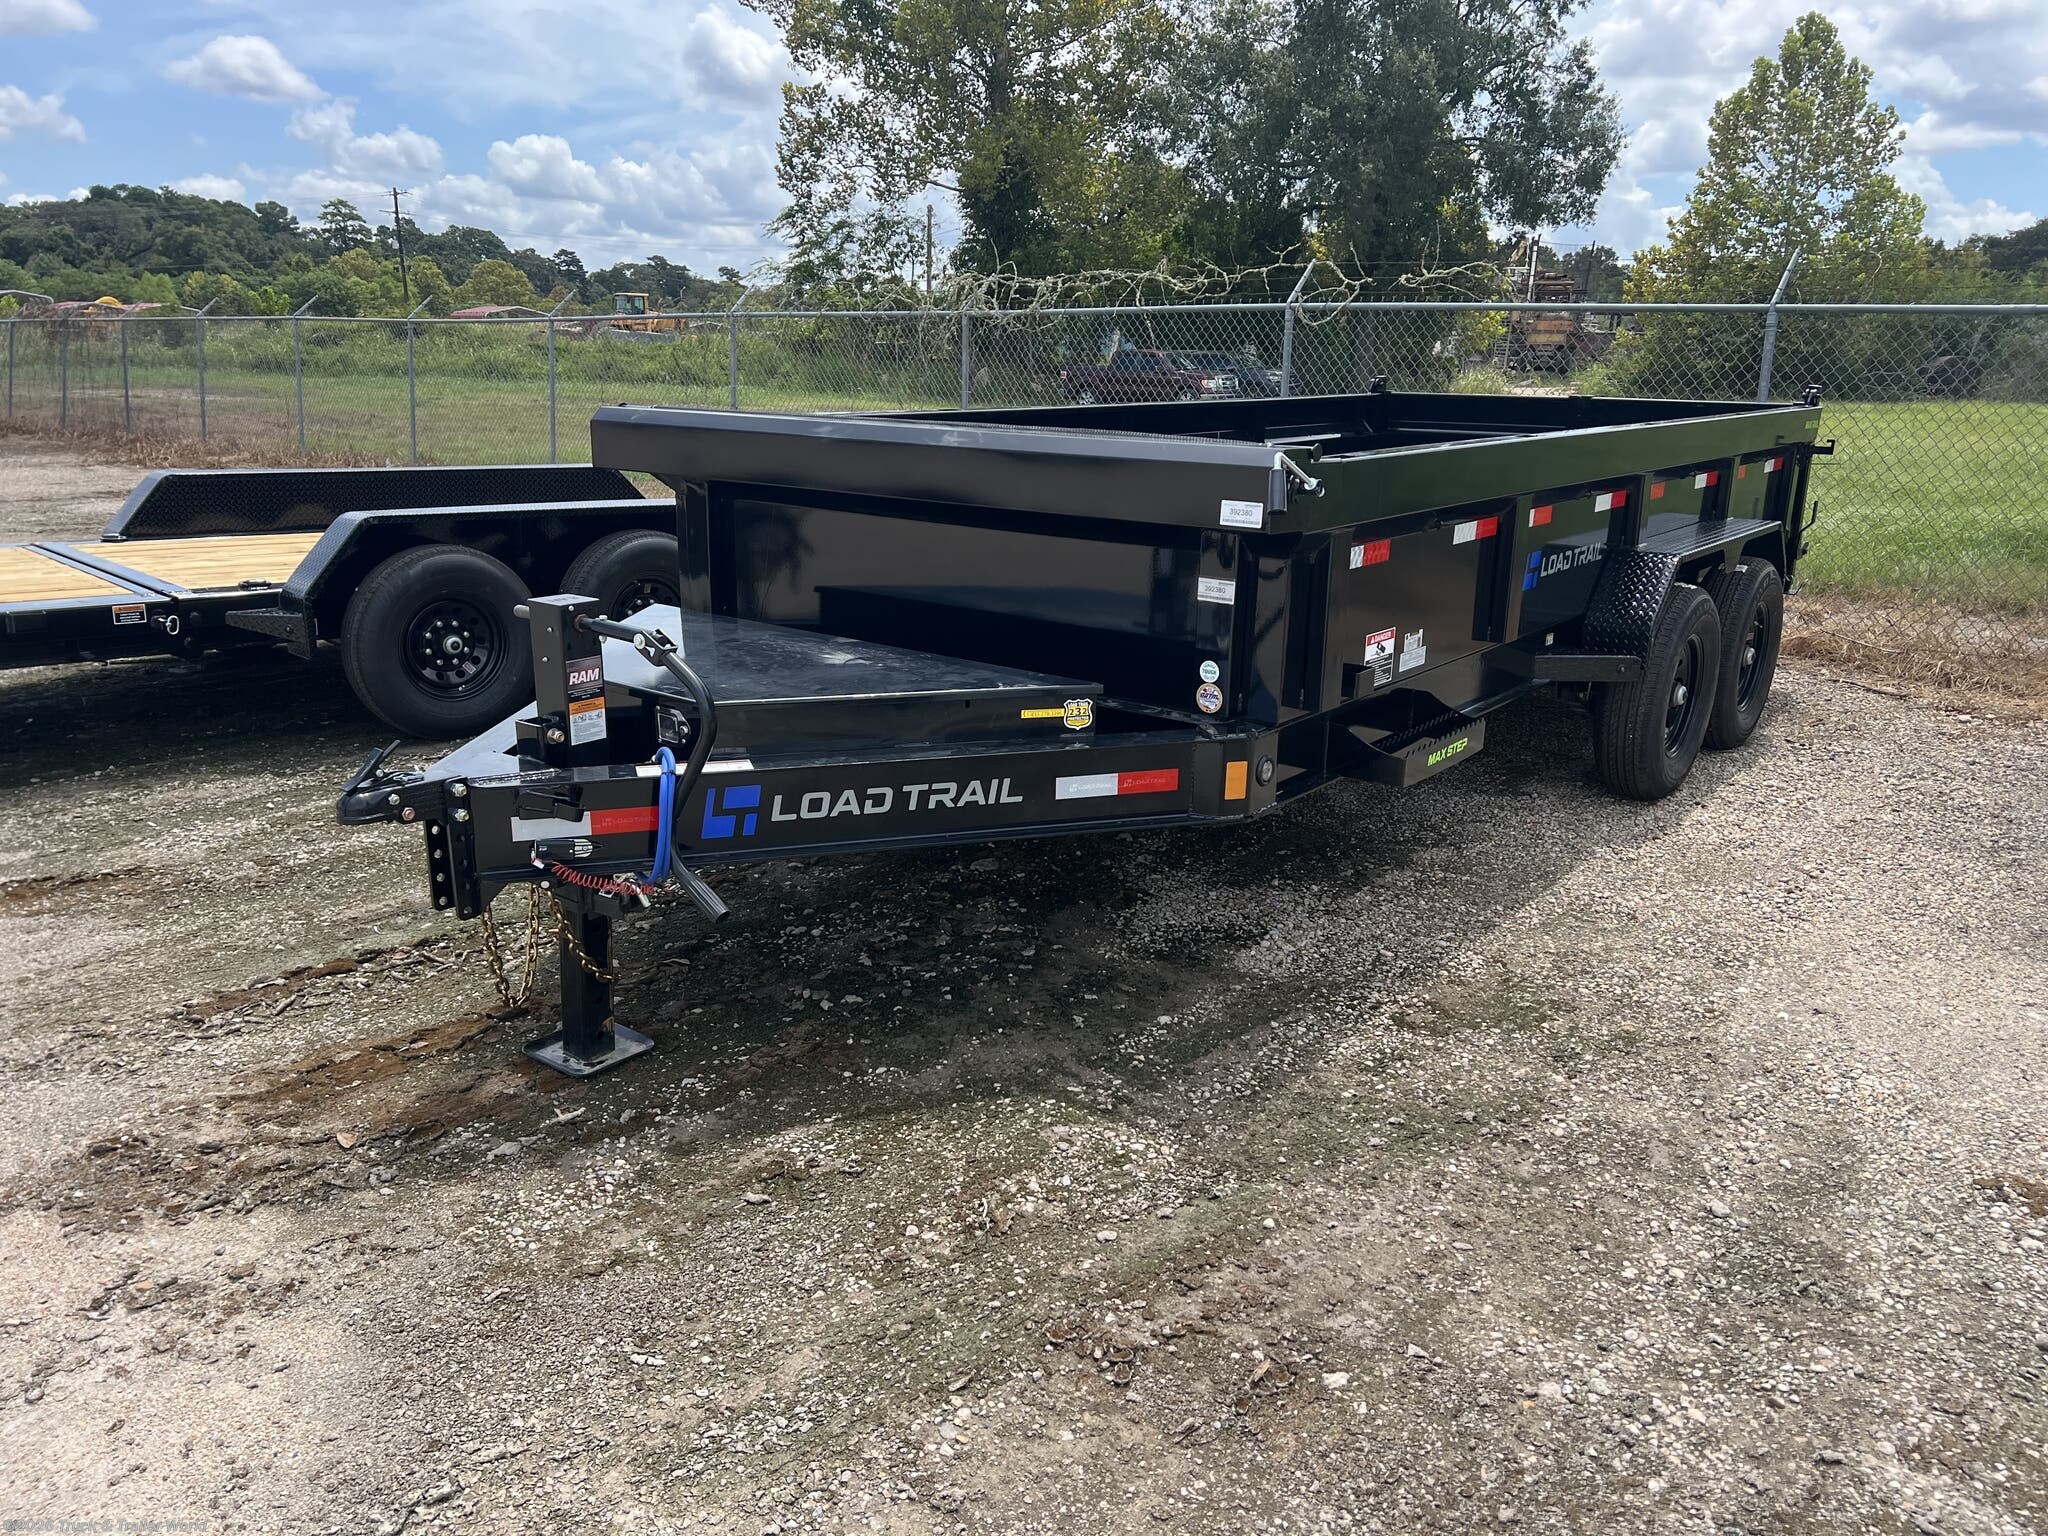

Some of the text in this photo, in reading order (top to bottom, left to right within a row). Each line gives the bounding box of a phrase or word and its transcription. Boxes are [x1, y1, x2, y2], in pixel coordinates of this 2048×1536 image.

[1540, 550, 1573, 577] LOAD
[1574, 541, 1602, 564] TRAIL
[568, 667, 600, 686] RAM
[1069, 707, 1087, 716] 232
[1427, 737, 1468, 767] MAX STEP
[771, 787, 894, 822] LOAD
[902, 777, 1024, 811] TRAIL
